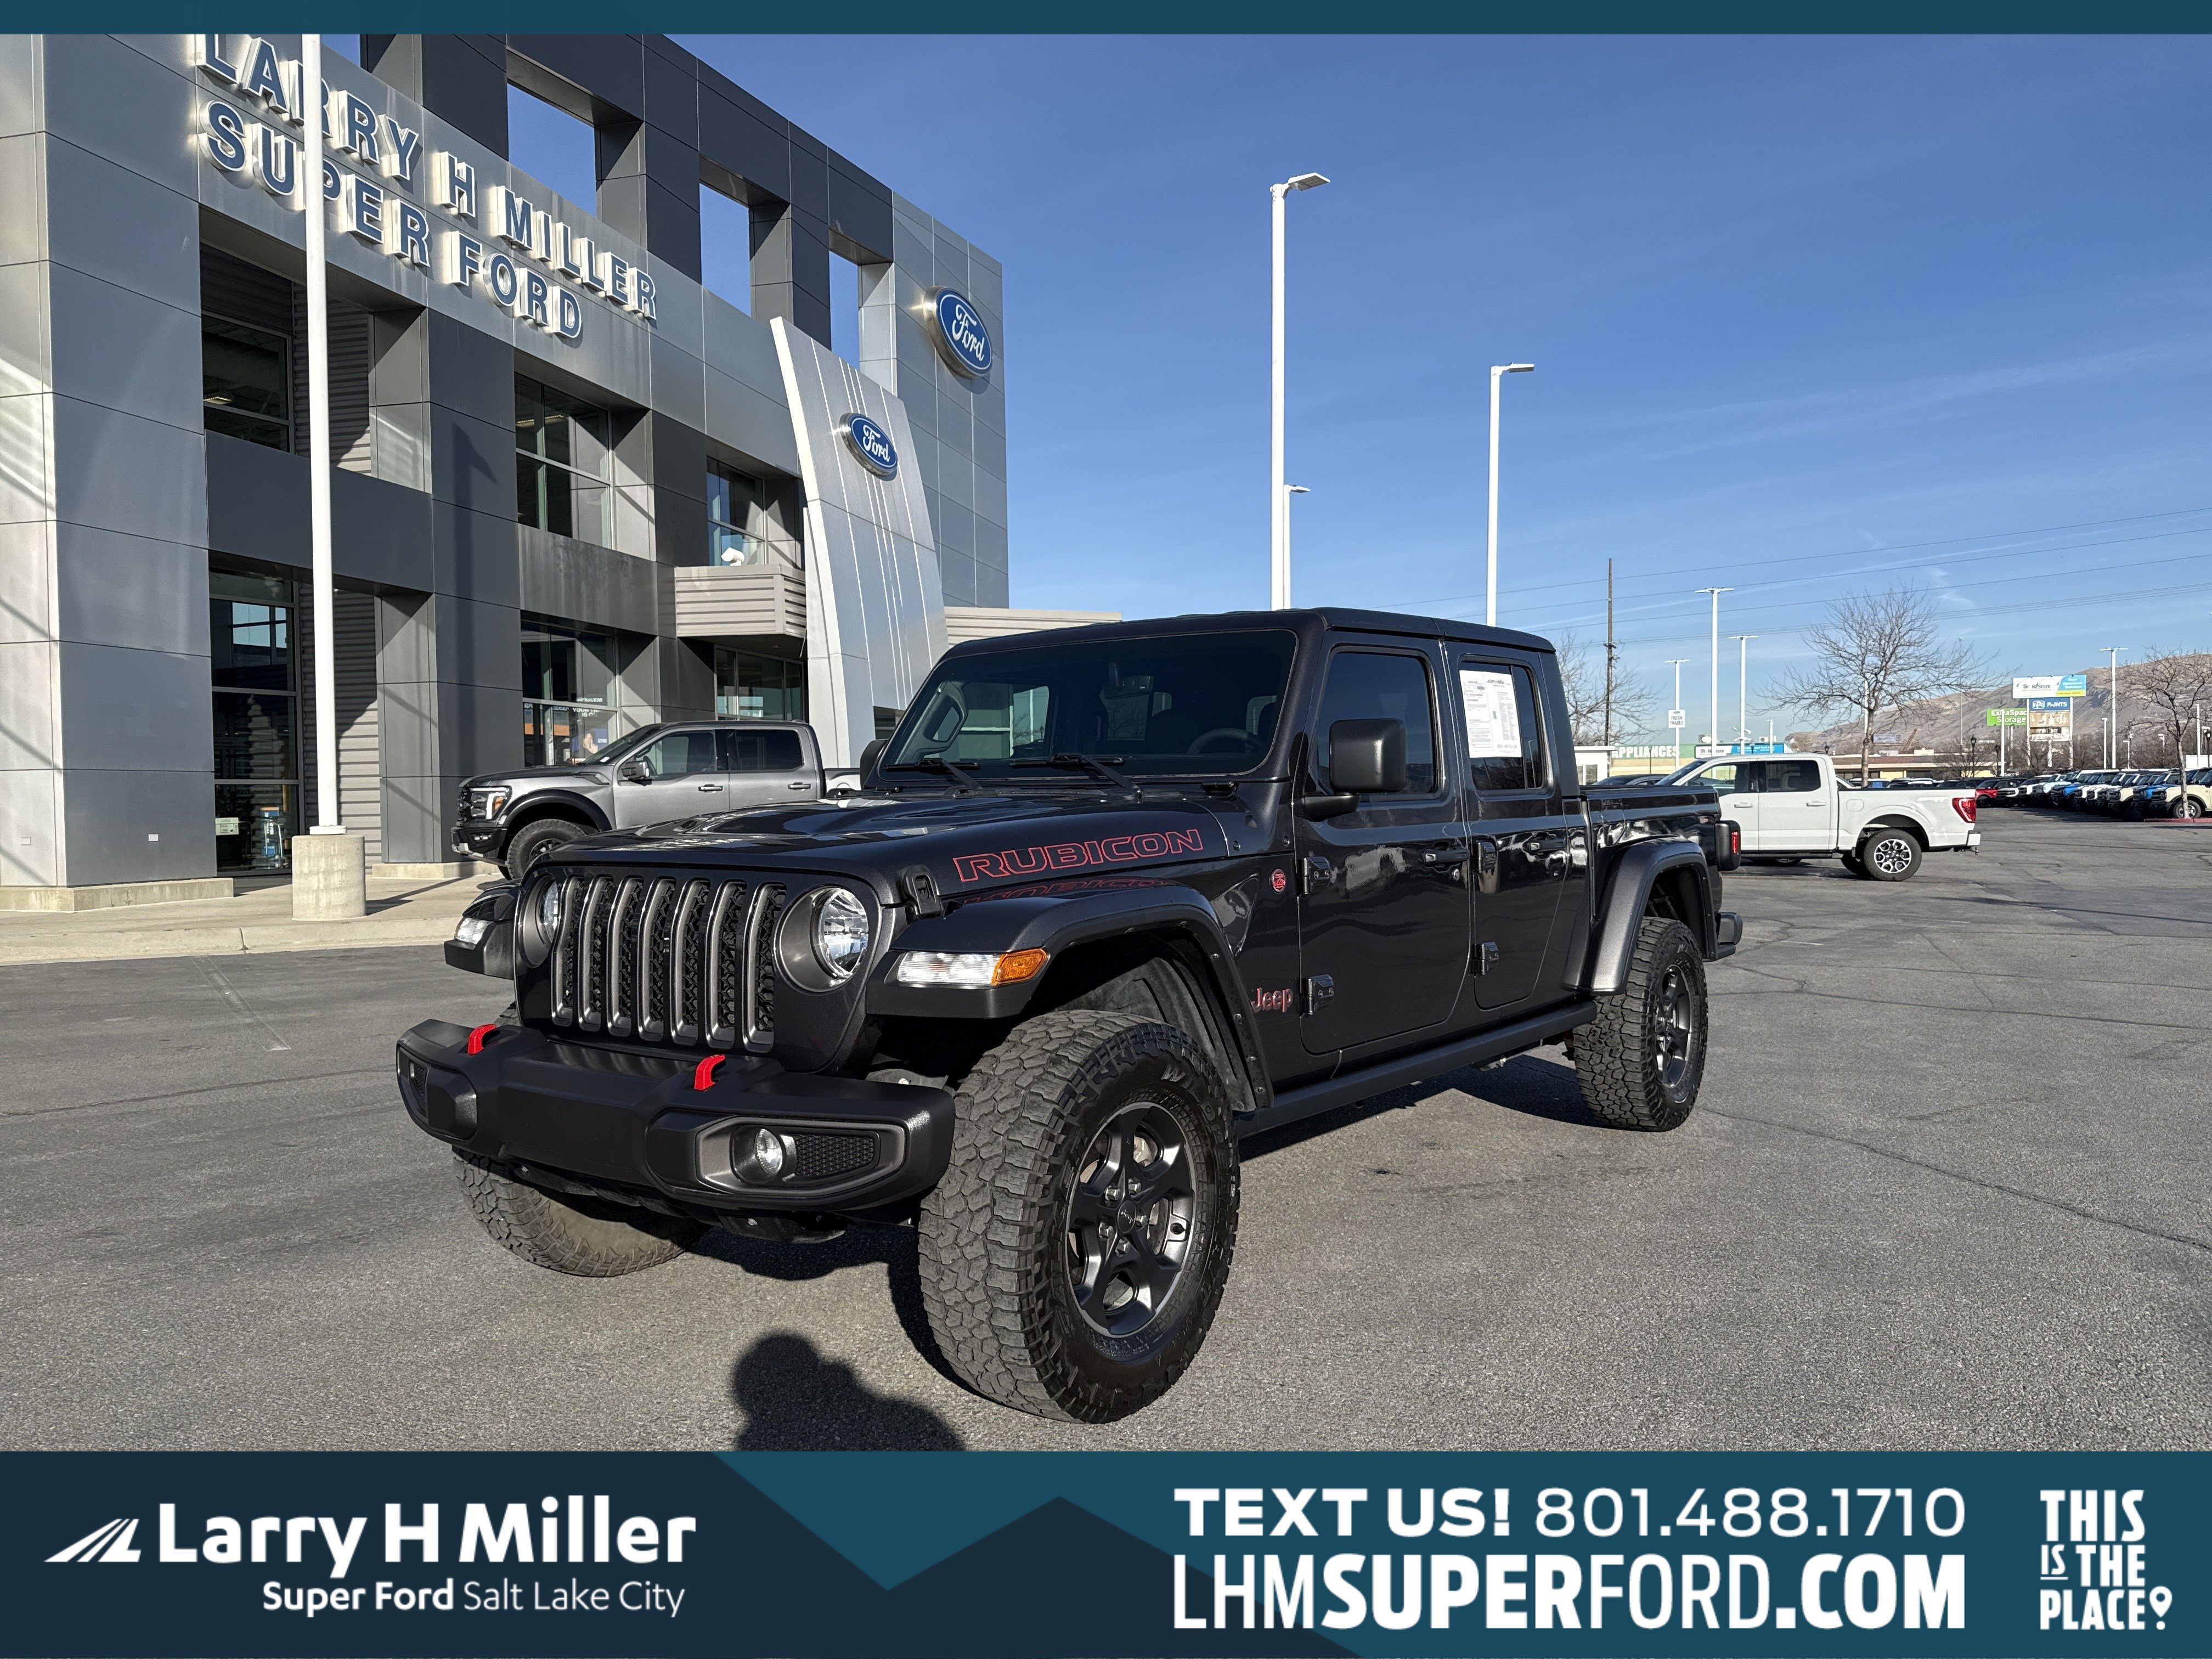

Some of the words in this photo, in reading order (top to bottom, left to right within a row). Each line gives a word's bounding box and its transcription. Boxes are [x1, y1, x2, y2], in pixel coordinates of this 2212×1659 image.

[440, 151, 476, 218] H
[496, 185, 657, 320] MILLER
[451, 230, 582, 338] FORD
[952, 303, 986, 362] Ford
[862, 425, 890, 463] Ford
[1611, 745, 1680, 758] APPLIANCES
[953, 828, 1203, 882] RUBICON
[1251, 988, 1293, 1013] Jeep
